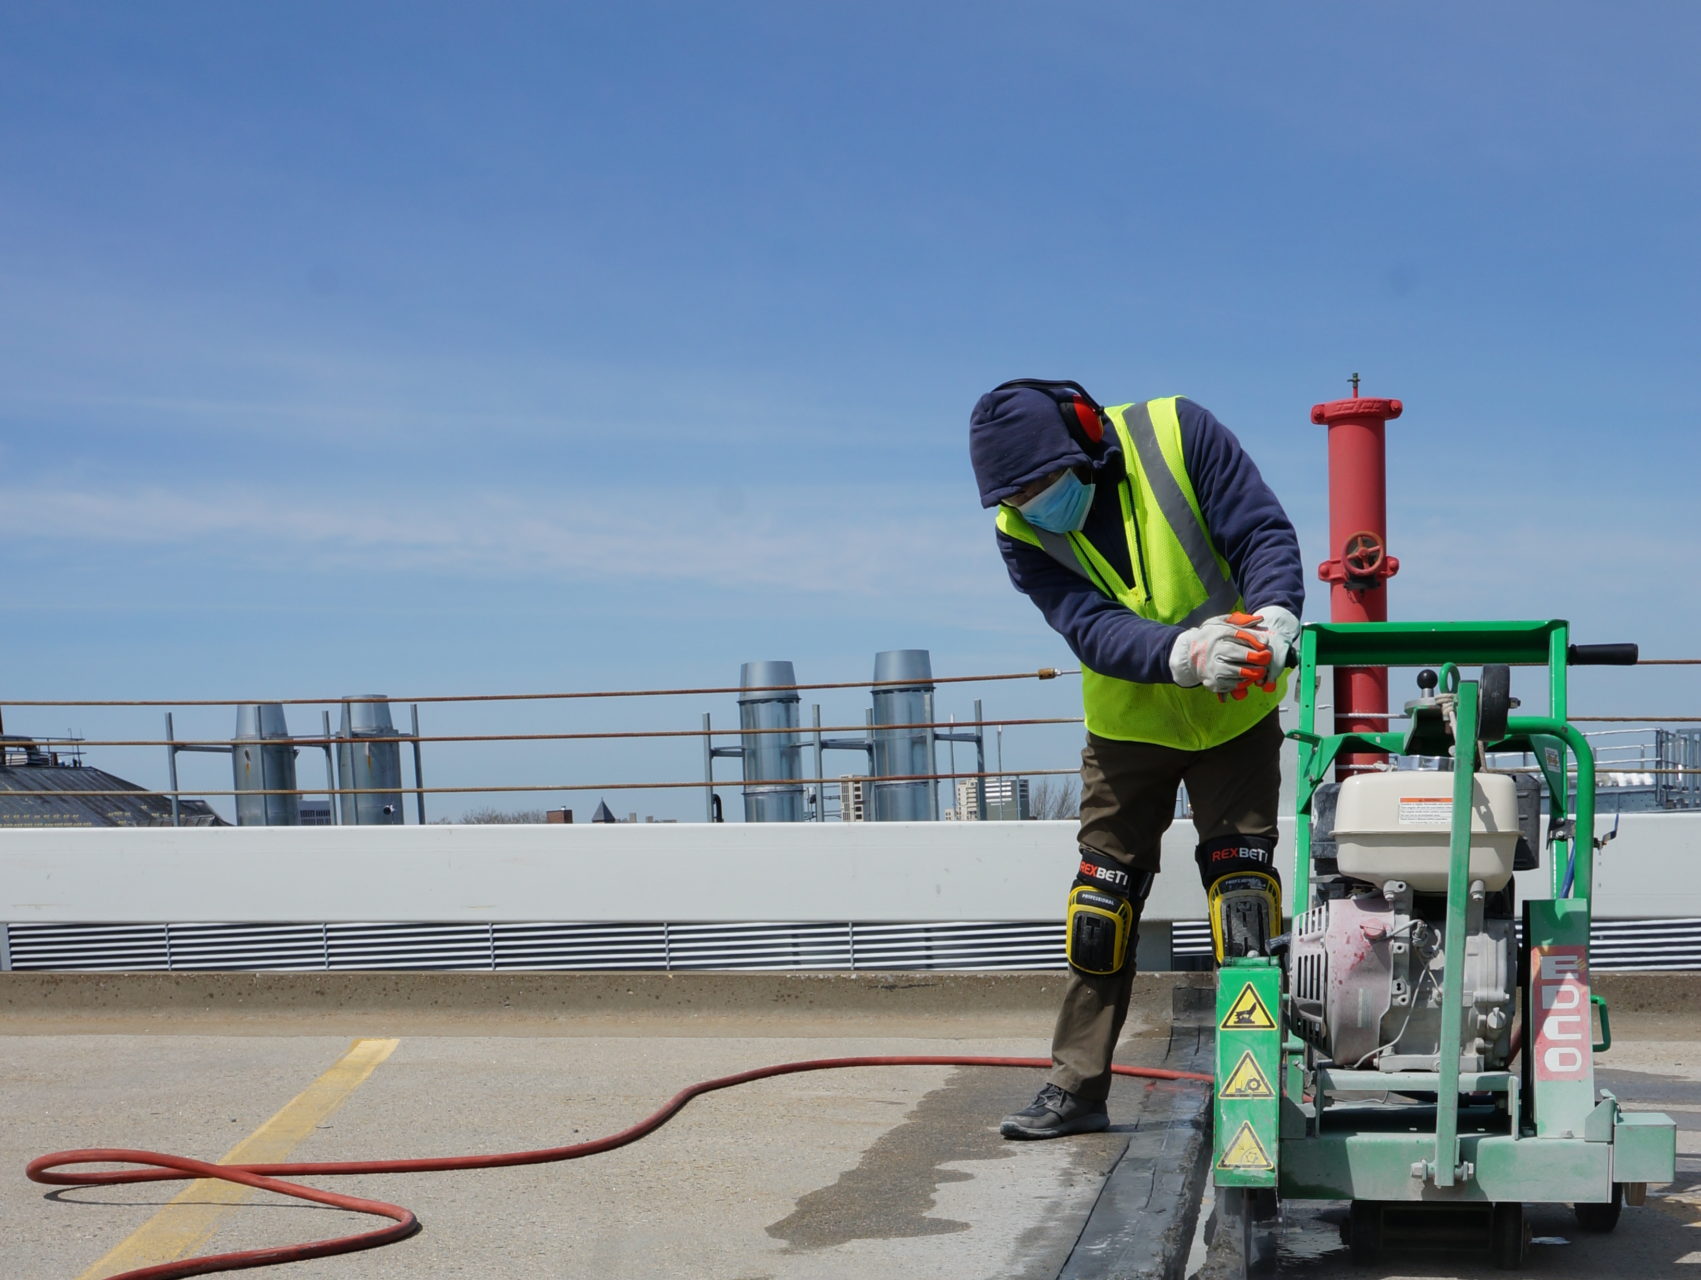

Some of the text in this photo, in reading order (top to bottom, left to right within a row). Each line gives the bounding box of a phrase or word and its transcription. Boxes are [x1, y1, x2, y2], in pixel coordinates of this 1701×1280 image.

[1212, 847, 1269, 864] REXBETI
[1080, 860, 1129, 886] REXBETI
[1540, 955, 1582, 1072] EDCO
